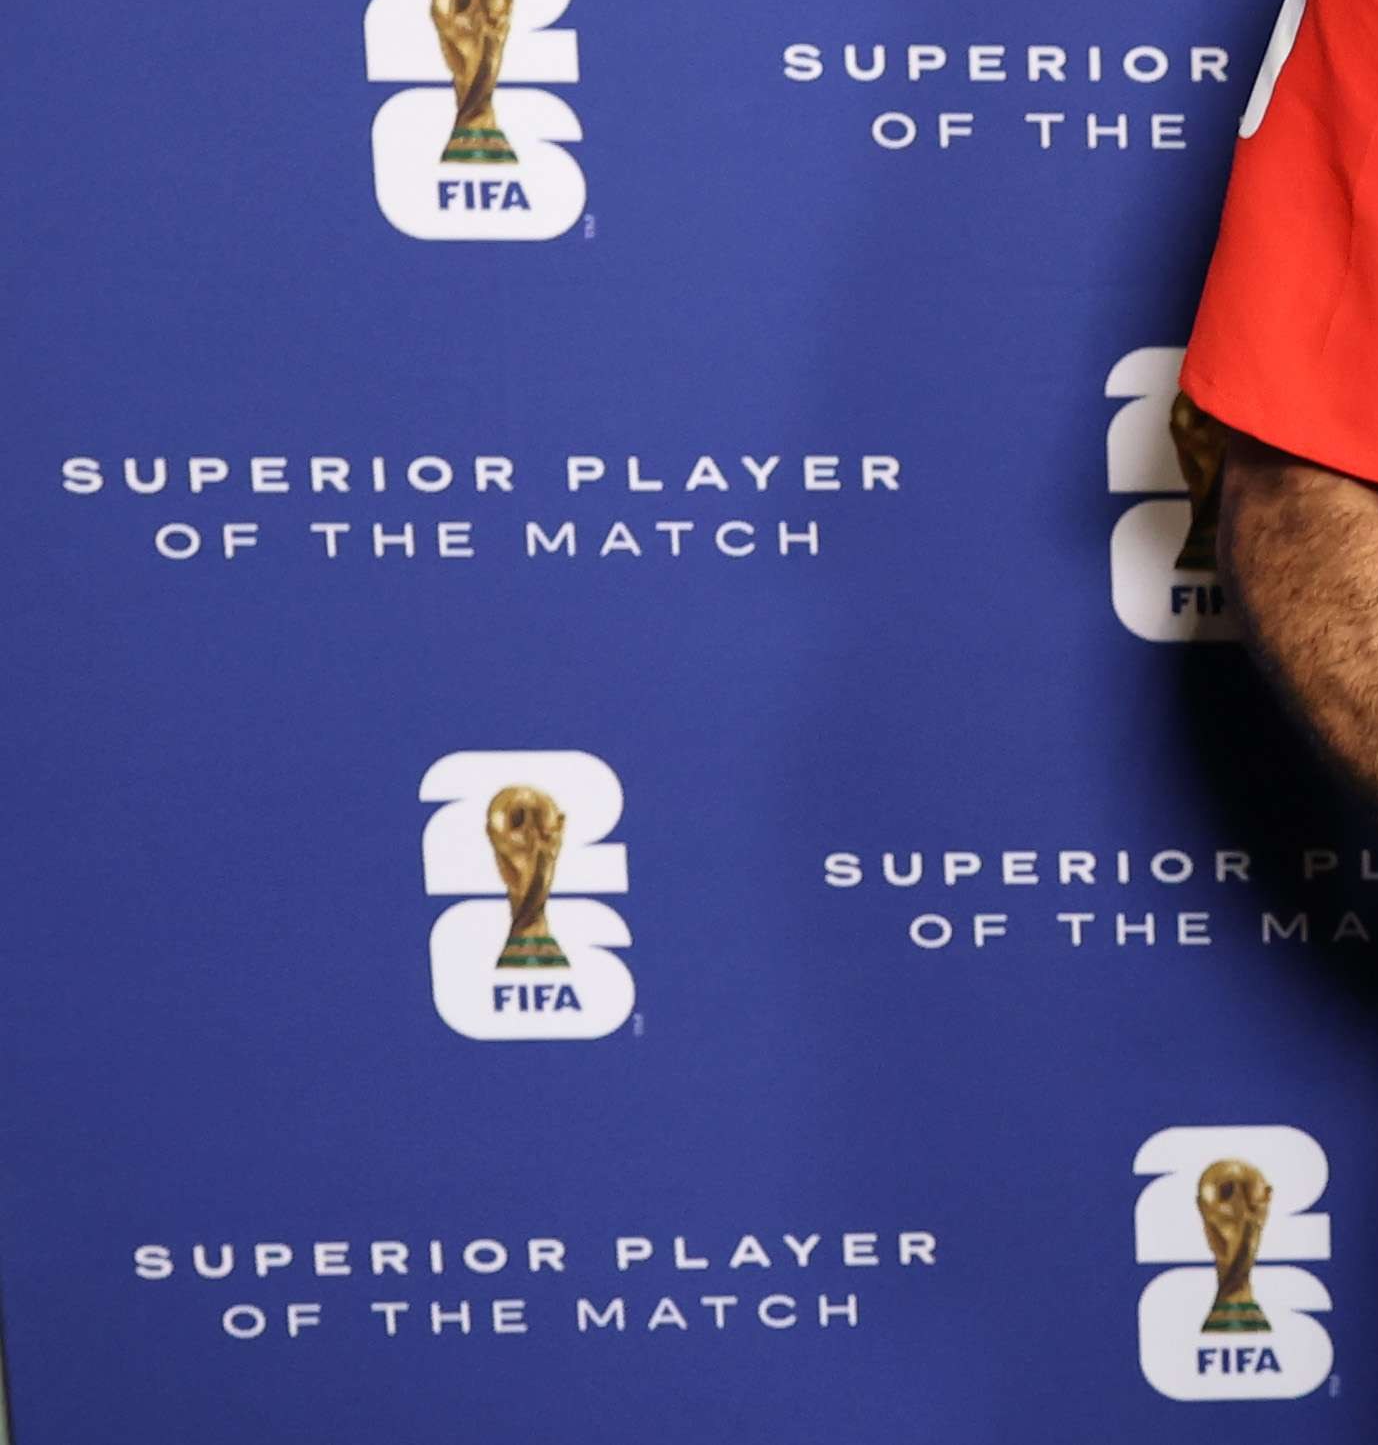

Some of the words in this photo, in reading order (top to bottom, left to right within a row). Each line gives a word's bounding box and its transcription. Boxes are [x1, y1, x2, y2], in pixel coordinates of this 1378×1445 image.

[783, 43, 1229, 84] SUPERIOR
[871, 111, 974, 150] OF
[1023, 112, 1187, 150] THE
[437, 179, 532, 211] FIFA
[61, 455, 514, 495] SUPERIOR
[566, 455, 900, 492] PLAYER
[154, 522, 259, 560] OF
[309, 521, 475, 558] THE
[525, 520, 819, 558] MATCH
[823, 849, 1249, 888] SUPERIOR
[908, 913, 1008, 949] OF
[1055, 912, 1212, 947] THE
[492, 983, 583, 1013] FIFA
[133, 1238, 566, 1280] SUPERIOR
[615, 1231, 937, 1271] PLAYER
[222, 1302, 322, 1339] OF
[370, 1299, 529, 1336] THE
[576, 1293, 858, 1332] MATCH
[1196, 1346, 1283, 1376] FIFA
